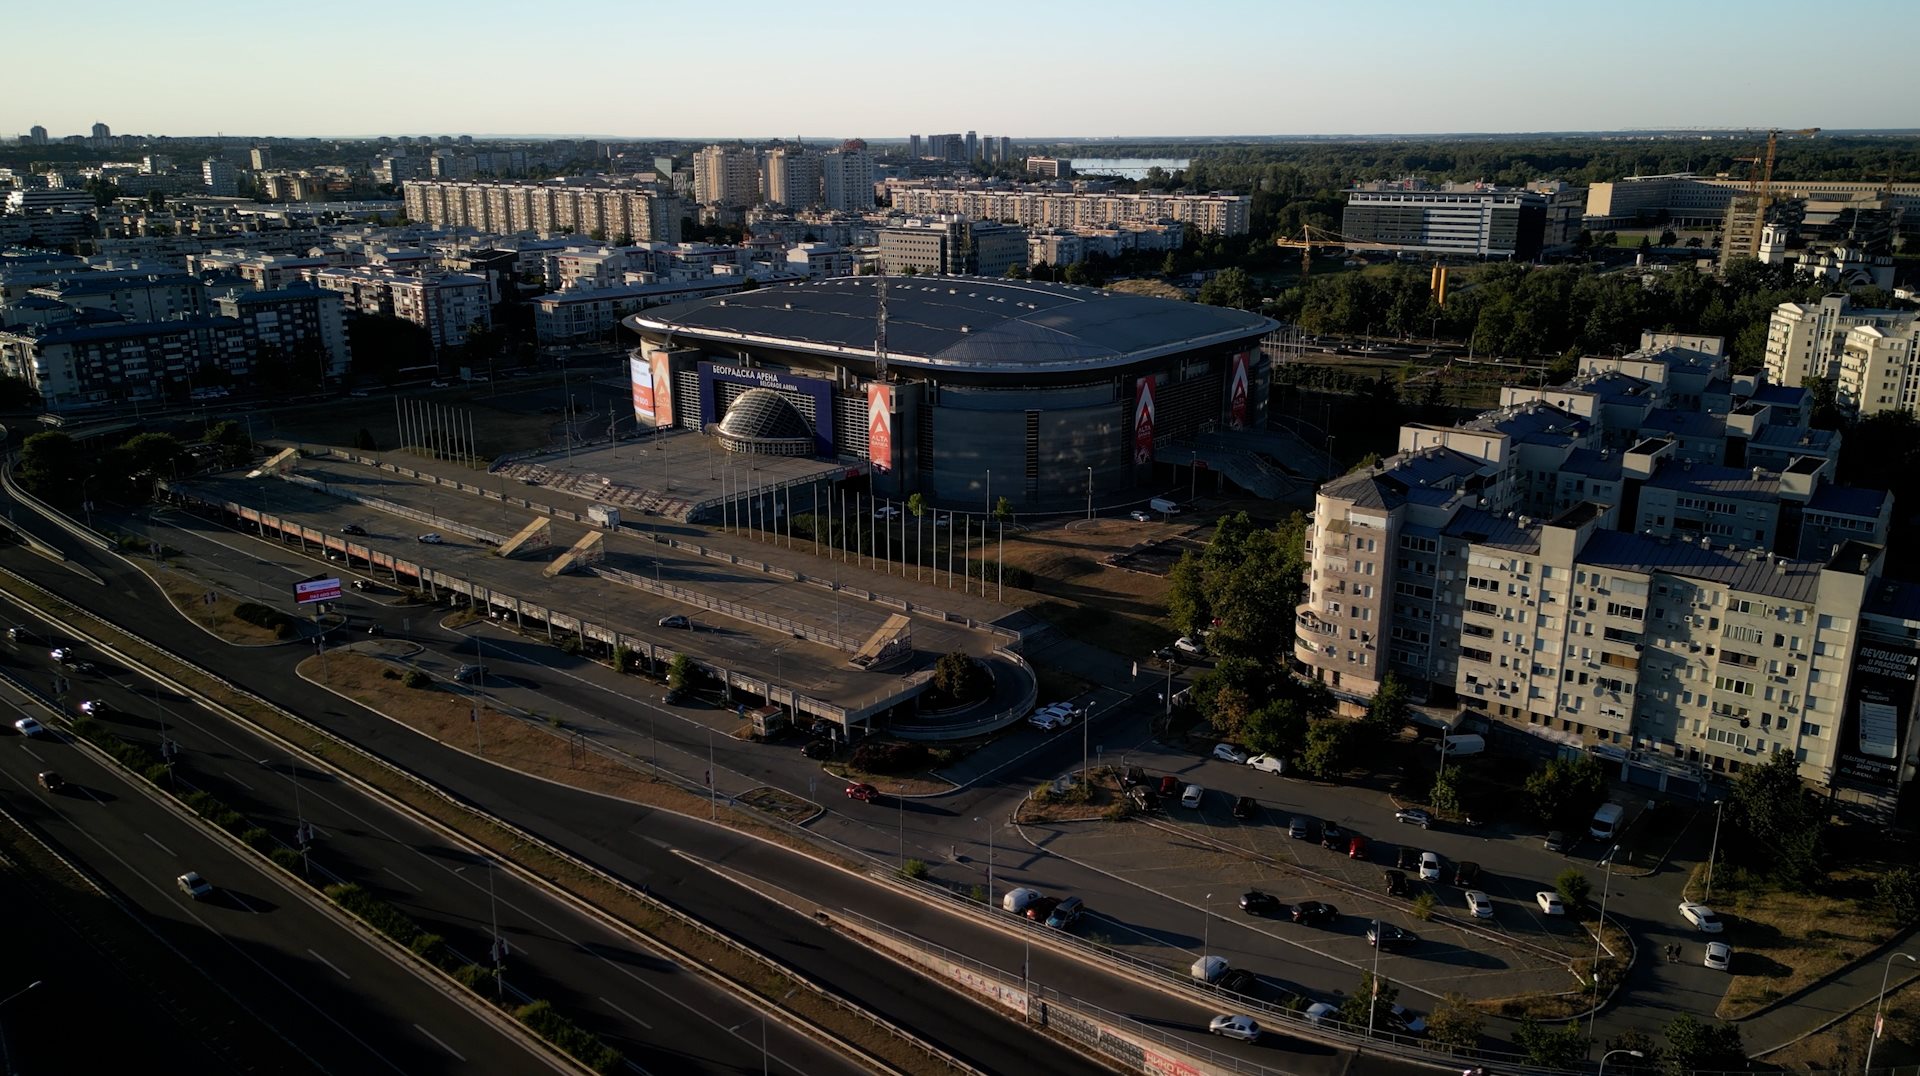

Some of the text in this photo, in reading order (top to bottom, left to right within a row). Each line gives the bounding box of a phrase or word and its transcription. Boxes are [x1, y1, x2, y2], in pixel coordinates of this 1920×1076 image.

[712, 365, 779, 383] БЕОГРАДСКА АРЕНА
[760, 380, 798, 391] BELGRADE ARENA
[871, 435, 888, 443] ALTA
[1860, 647, 1918, 666] REVOLUCIJA
[1857, 664, 1881, 675] SPORTA
